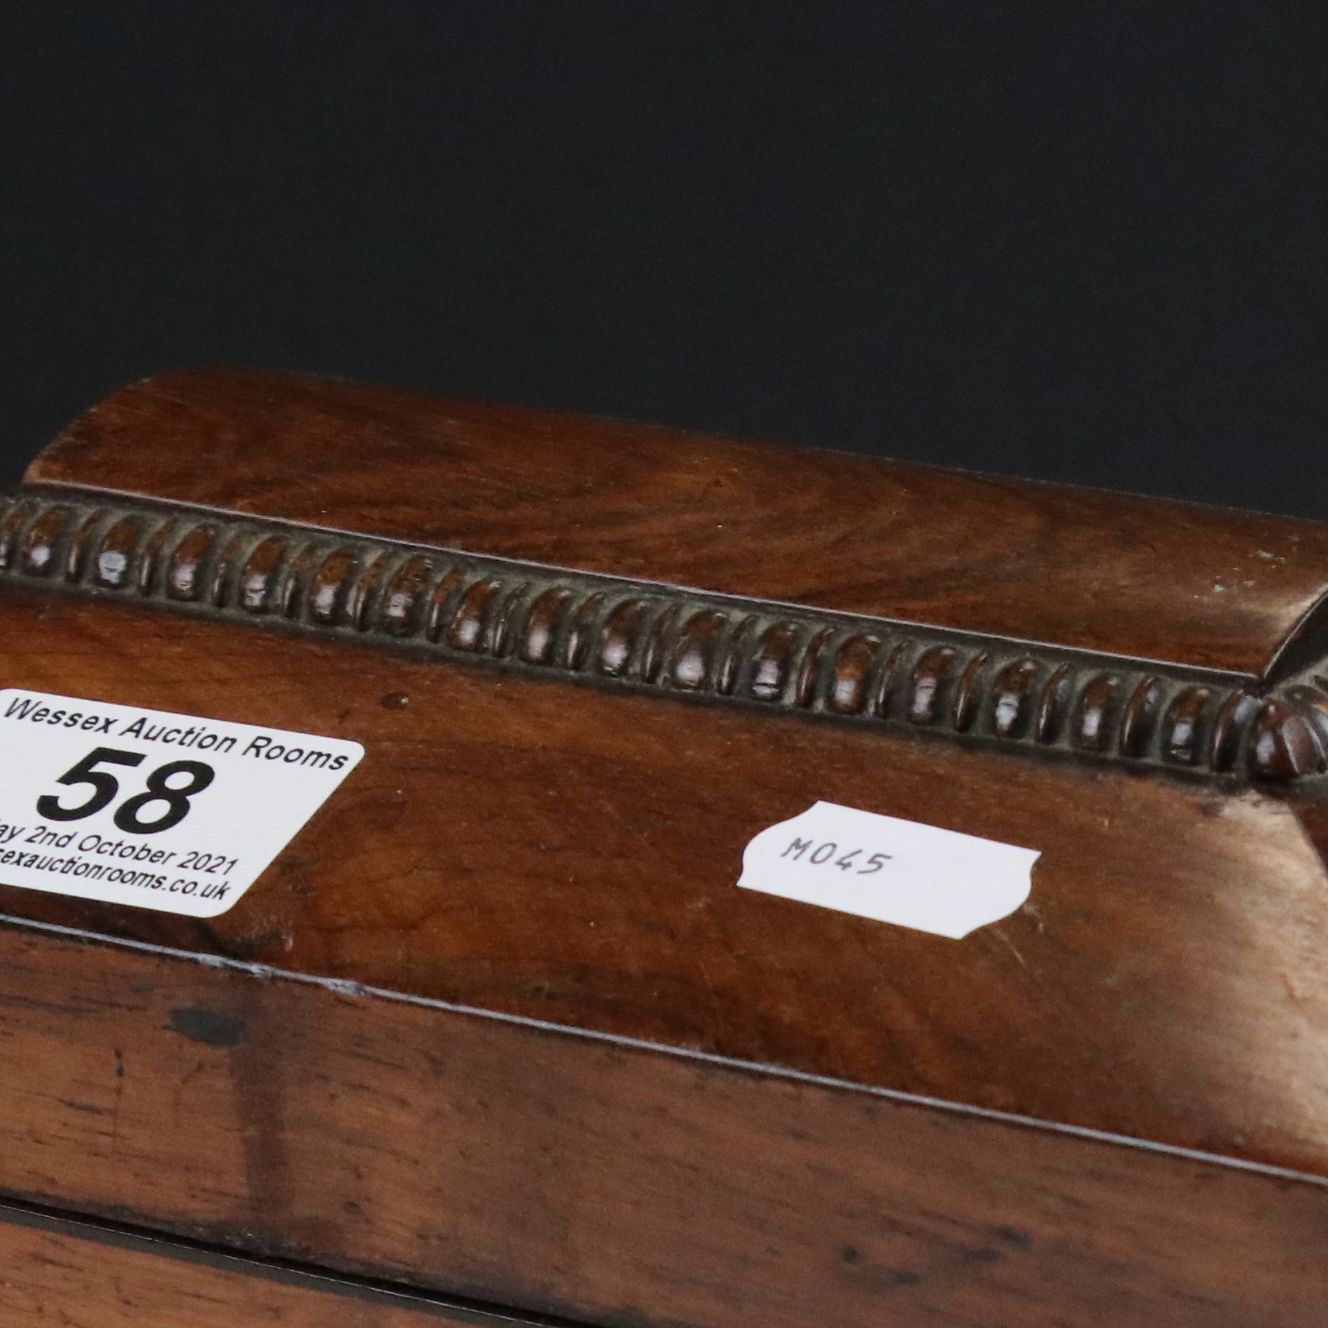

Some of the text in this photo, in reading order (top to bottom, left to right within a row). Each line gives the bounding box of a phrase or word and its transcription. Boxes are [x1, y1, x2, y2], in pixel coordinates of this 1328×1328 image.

[3, 697, 350, 771] Wessex Auction Rooms
[36, 746, 215, 835] 58
[24, 825, 72, 849] 2nd
[79, 834, 176, 865] October
[177, 851, 238, 876] 2021
